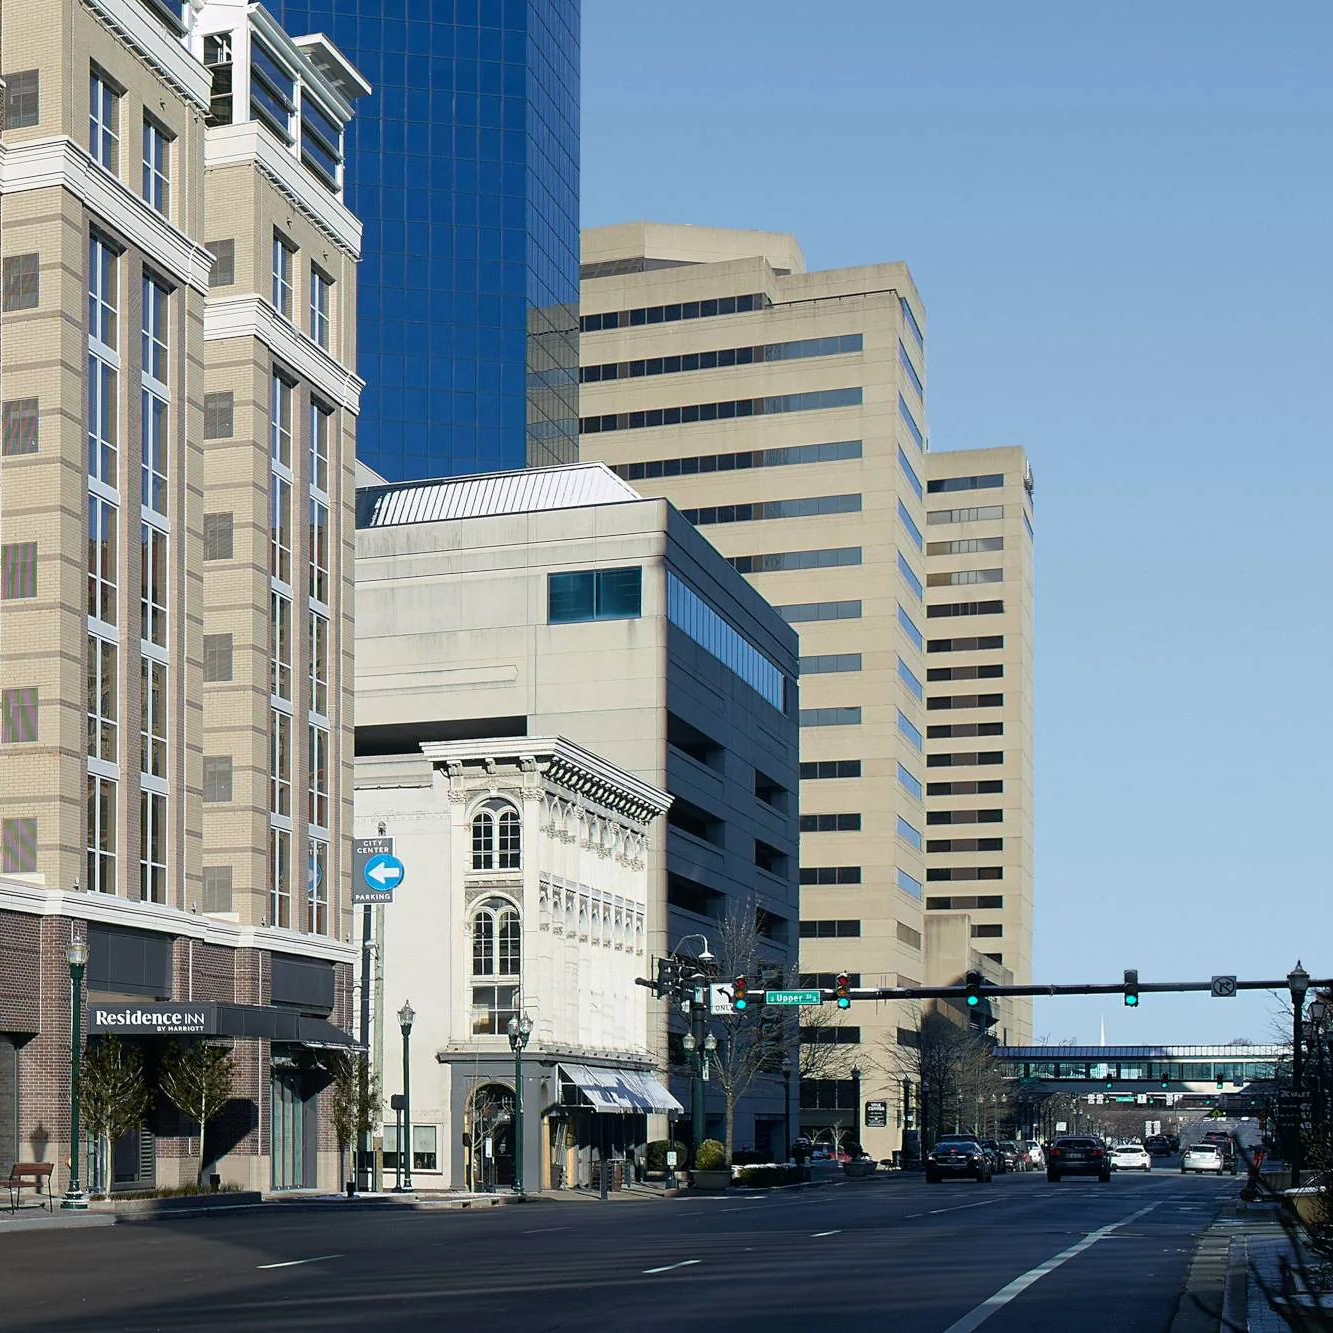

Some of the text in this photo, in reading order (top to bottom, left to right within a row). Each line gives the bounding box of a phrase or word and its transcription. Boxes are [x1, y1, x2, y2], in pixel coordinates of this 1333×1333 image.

[355, 893, 391, 901] PARKING
[776, 993, 803, 1003] Upper
[95, 1009, 205, 1026] Residence INN
